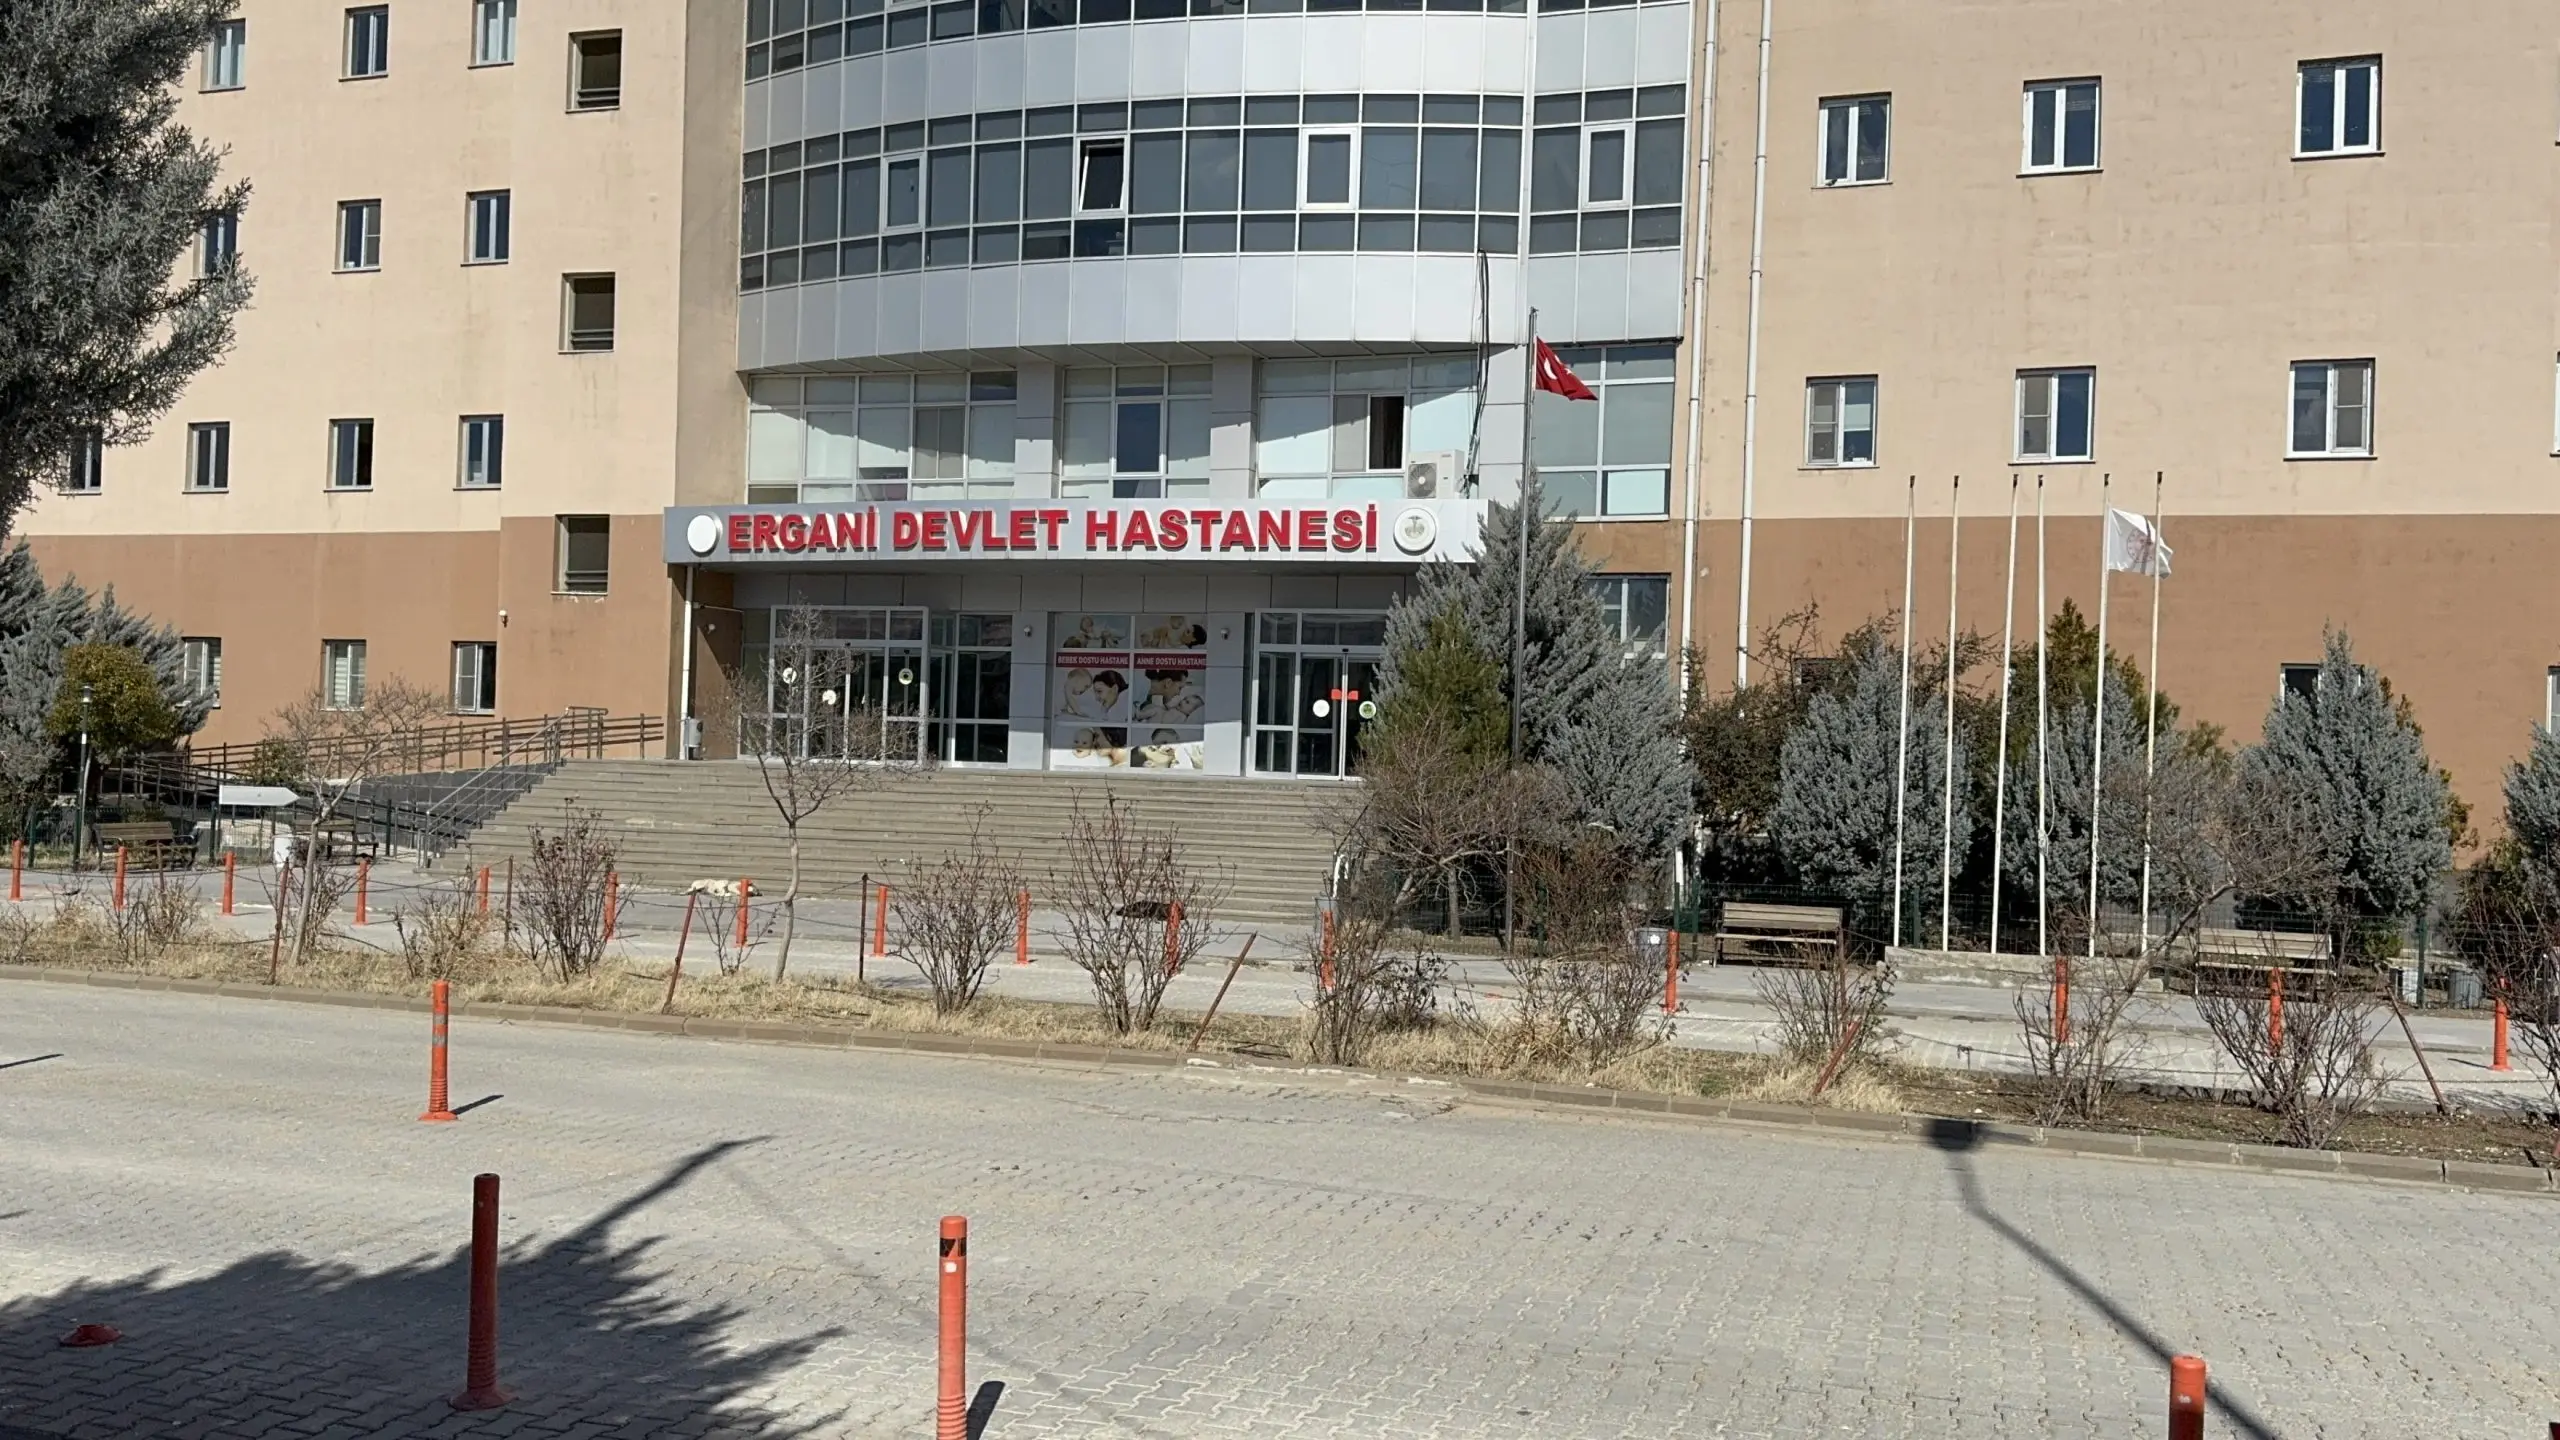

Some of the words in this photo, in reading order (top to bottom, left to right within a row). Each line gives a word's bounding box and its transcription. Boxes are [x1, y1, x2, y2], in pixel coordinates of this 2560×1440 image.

[728, 506, 879, 552] ERGANİ
[893, 509, 1068, 552] DEVLET
[1086, 503, 1377, 552] HASTANESİ
[1079, 656, 1099, 664] DOSTU
[1155, 657, 1177, 666] DOSTU
